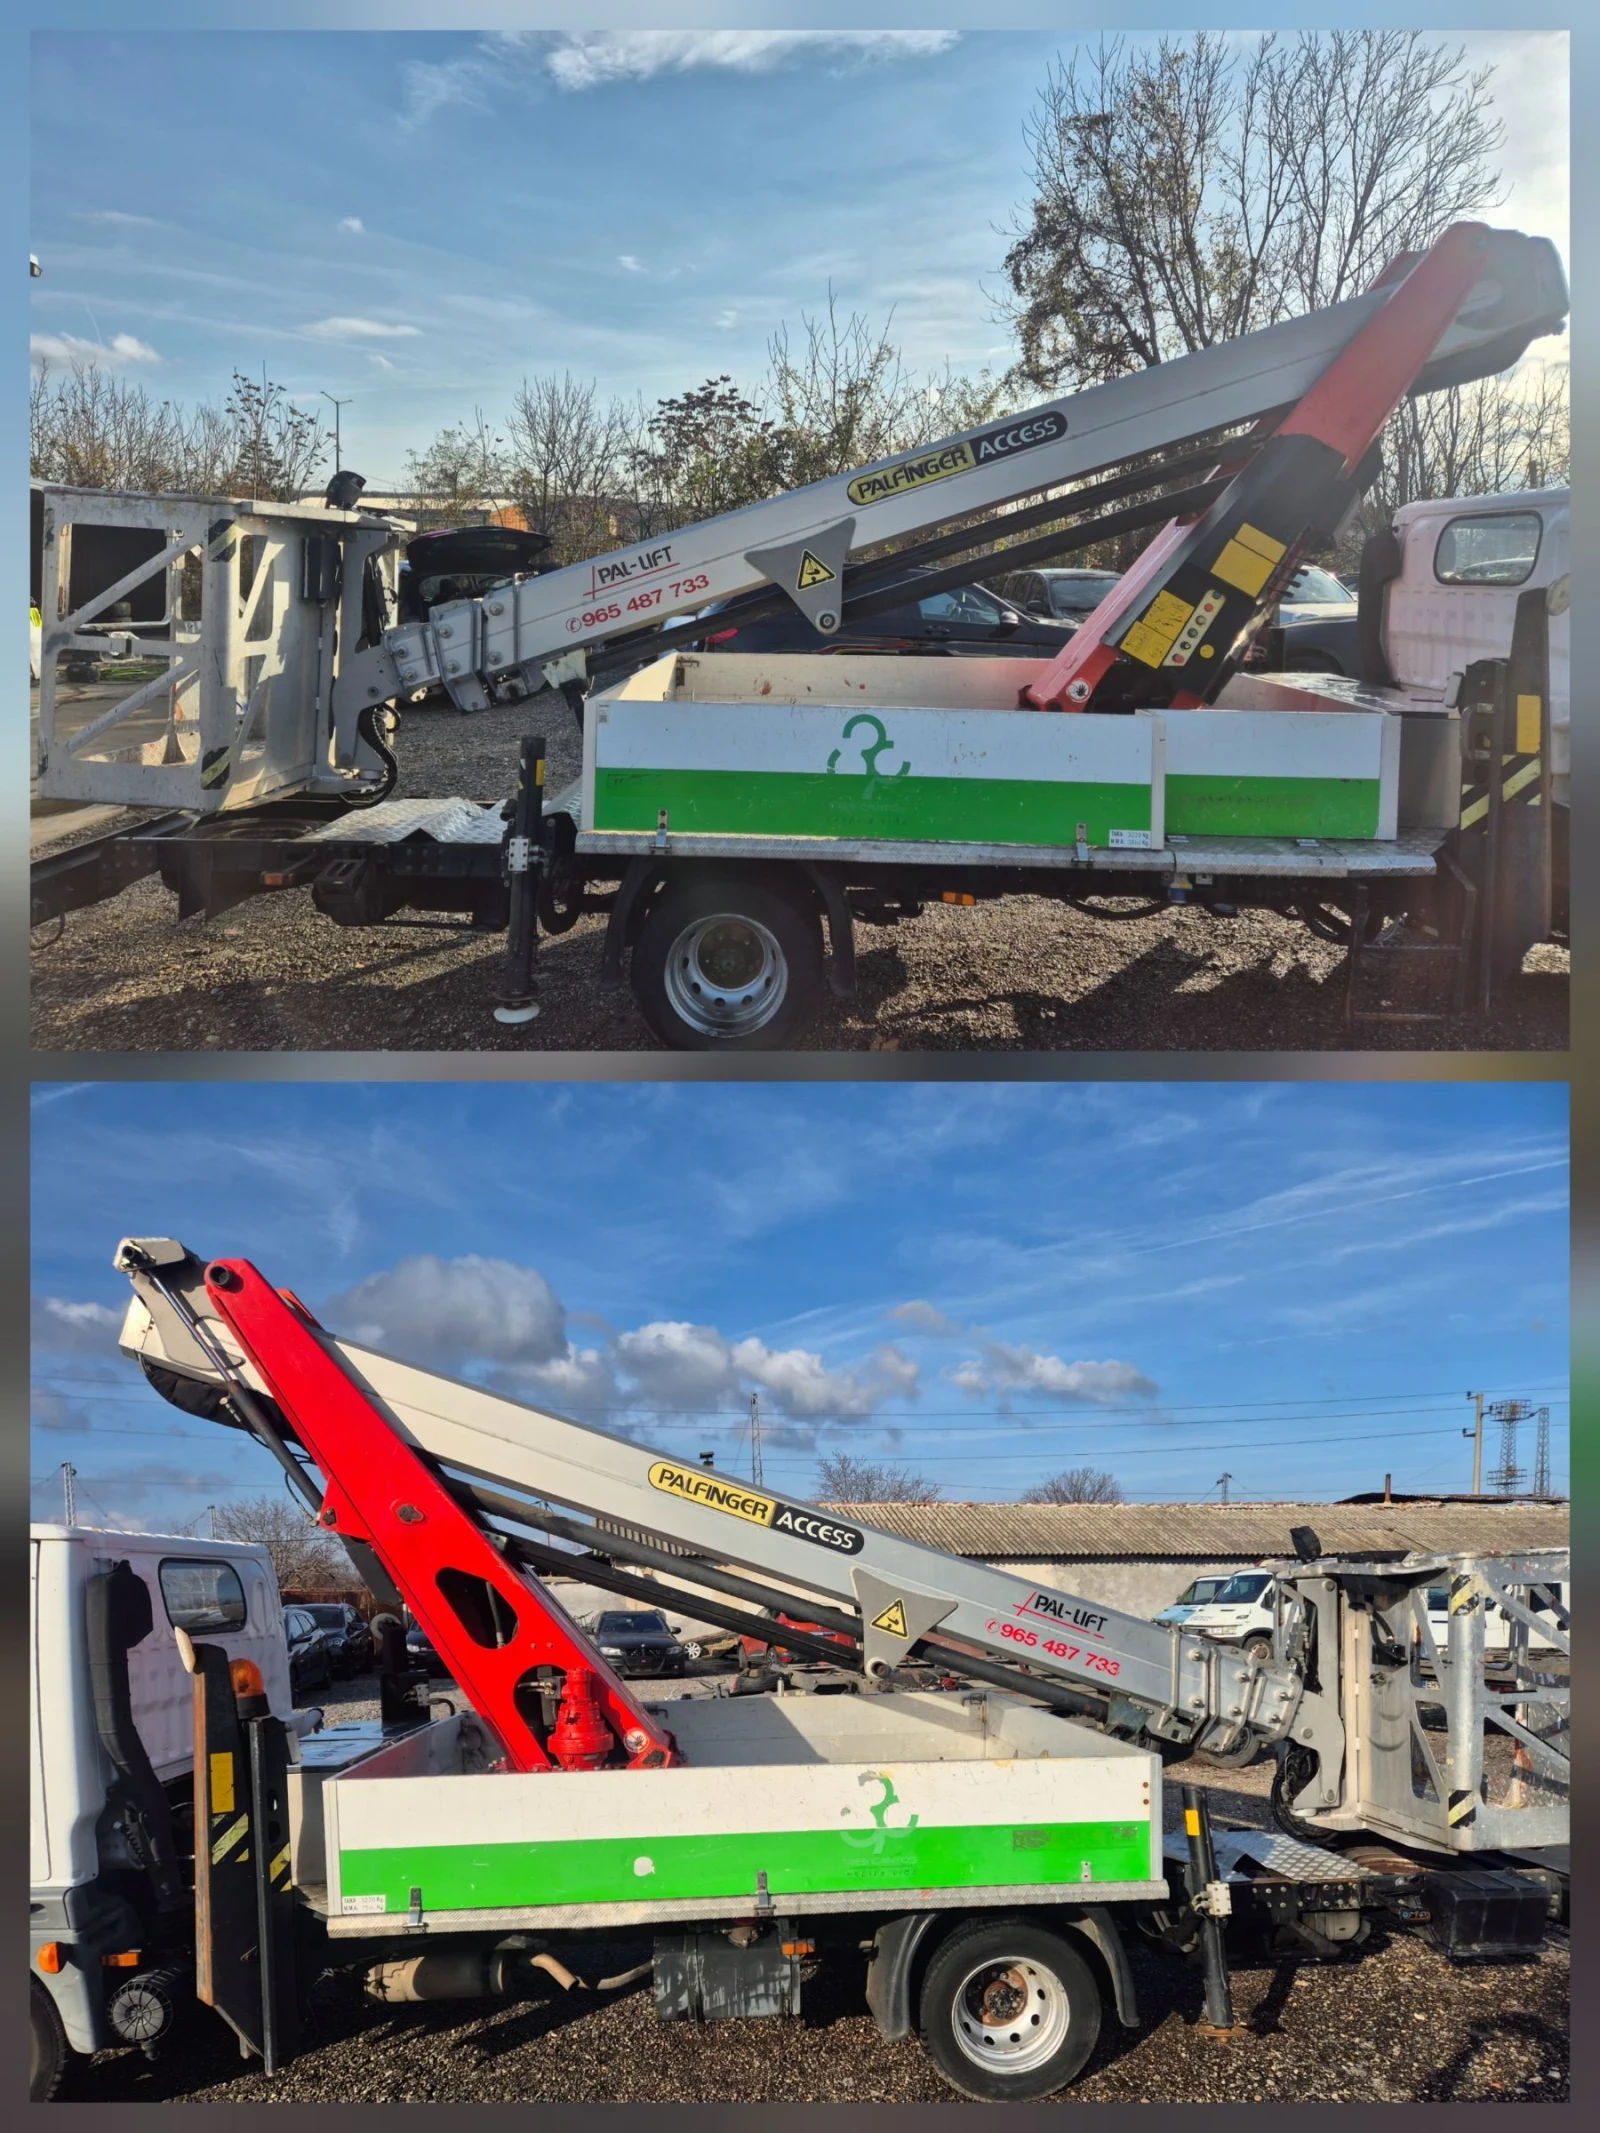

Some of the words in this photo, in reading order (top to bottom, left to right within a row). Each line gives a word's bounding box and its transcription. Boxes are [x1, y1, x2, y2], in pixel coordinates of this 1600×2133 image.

[857, 449, 968, 500] PALFINGER
[979, 417, 1058, 459] ACCESS
[598, 546, 672, 584] PAL-LIFT
[582, 604, 621, 627] 965
[626, 589, 662, 612] 487
[669, 574, 709, 598] 733
[658, 1469, 769, 1519] PALFINGER
[776, 1511, 855, 1549] ACCESS
[1034, 1594, 1108, 1631] PAL-LIFT
[1001, 1624, 1039, 1647] 965
[1042, 1640, 1080, 1661] 487
[1085, 1653, 1121, 1676] 733
